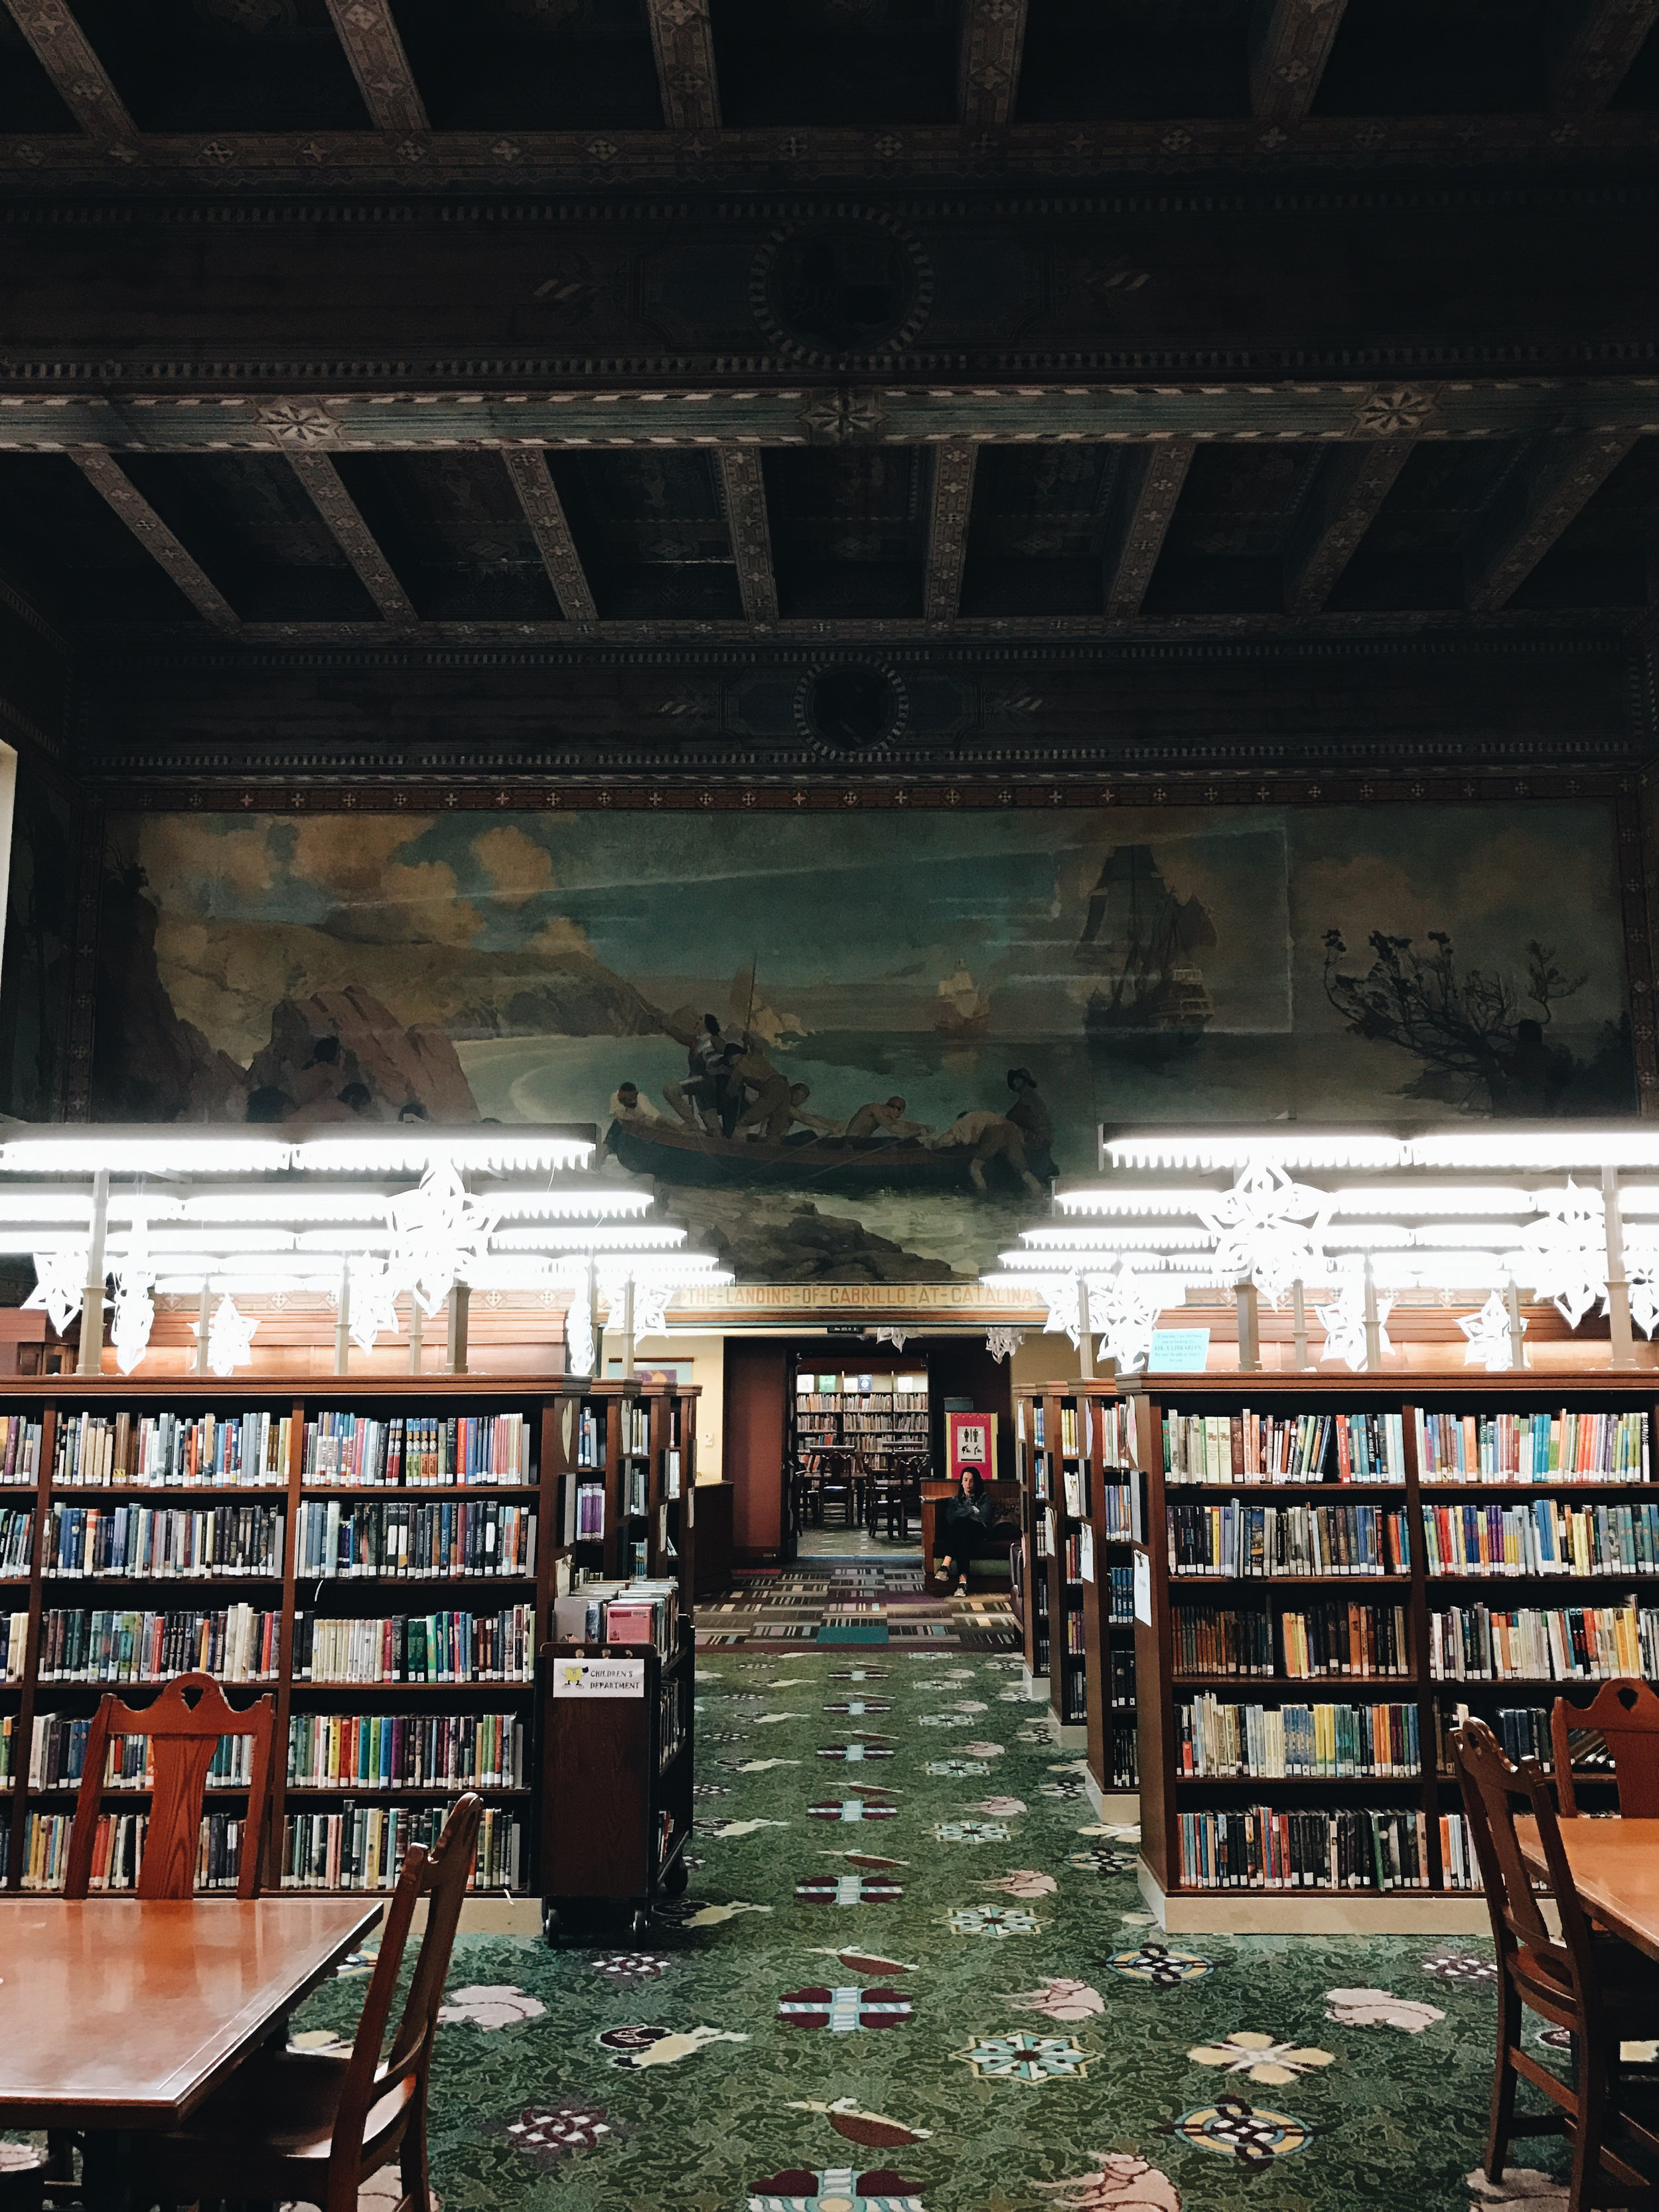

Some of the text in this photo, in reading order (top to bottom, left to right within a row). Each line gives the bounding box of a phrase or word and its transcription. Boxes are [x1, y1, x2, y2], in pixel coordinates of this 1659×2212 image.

[687, 1287, 1033, 1304] THE LANDING OF CABRILLO AT CATALINA
